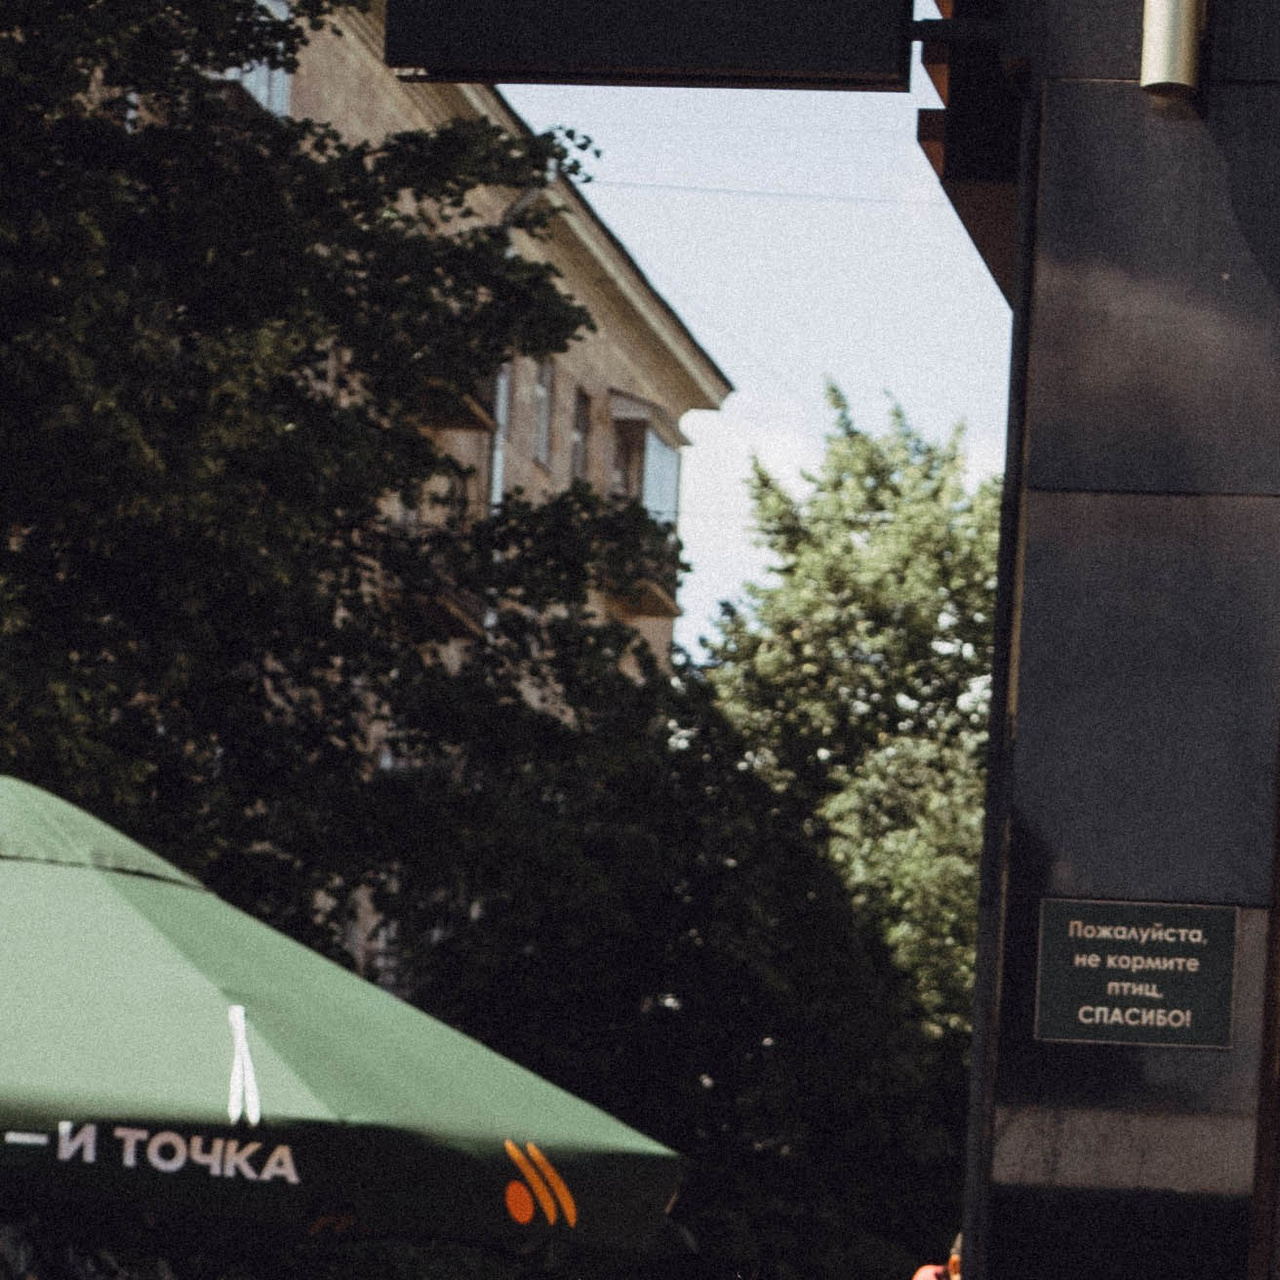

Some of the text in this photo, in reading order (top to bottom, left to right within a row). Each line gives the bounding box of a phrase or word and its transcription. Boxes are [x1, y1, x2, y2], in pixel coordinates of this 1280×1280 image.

[1067, 920, 1208, 946] Пожалуйста,
[1073, 953, 1201, 973] не кормите
[1077, 1005, 1193, 1028] СПАСИБО!
[113, 1127, 301, 1185] ТОЧКА
